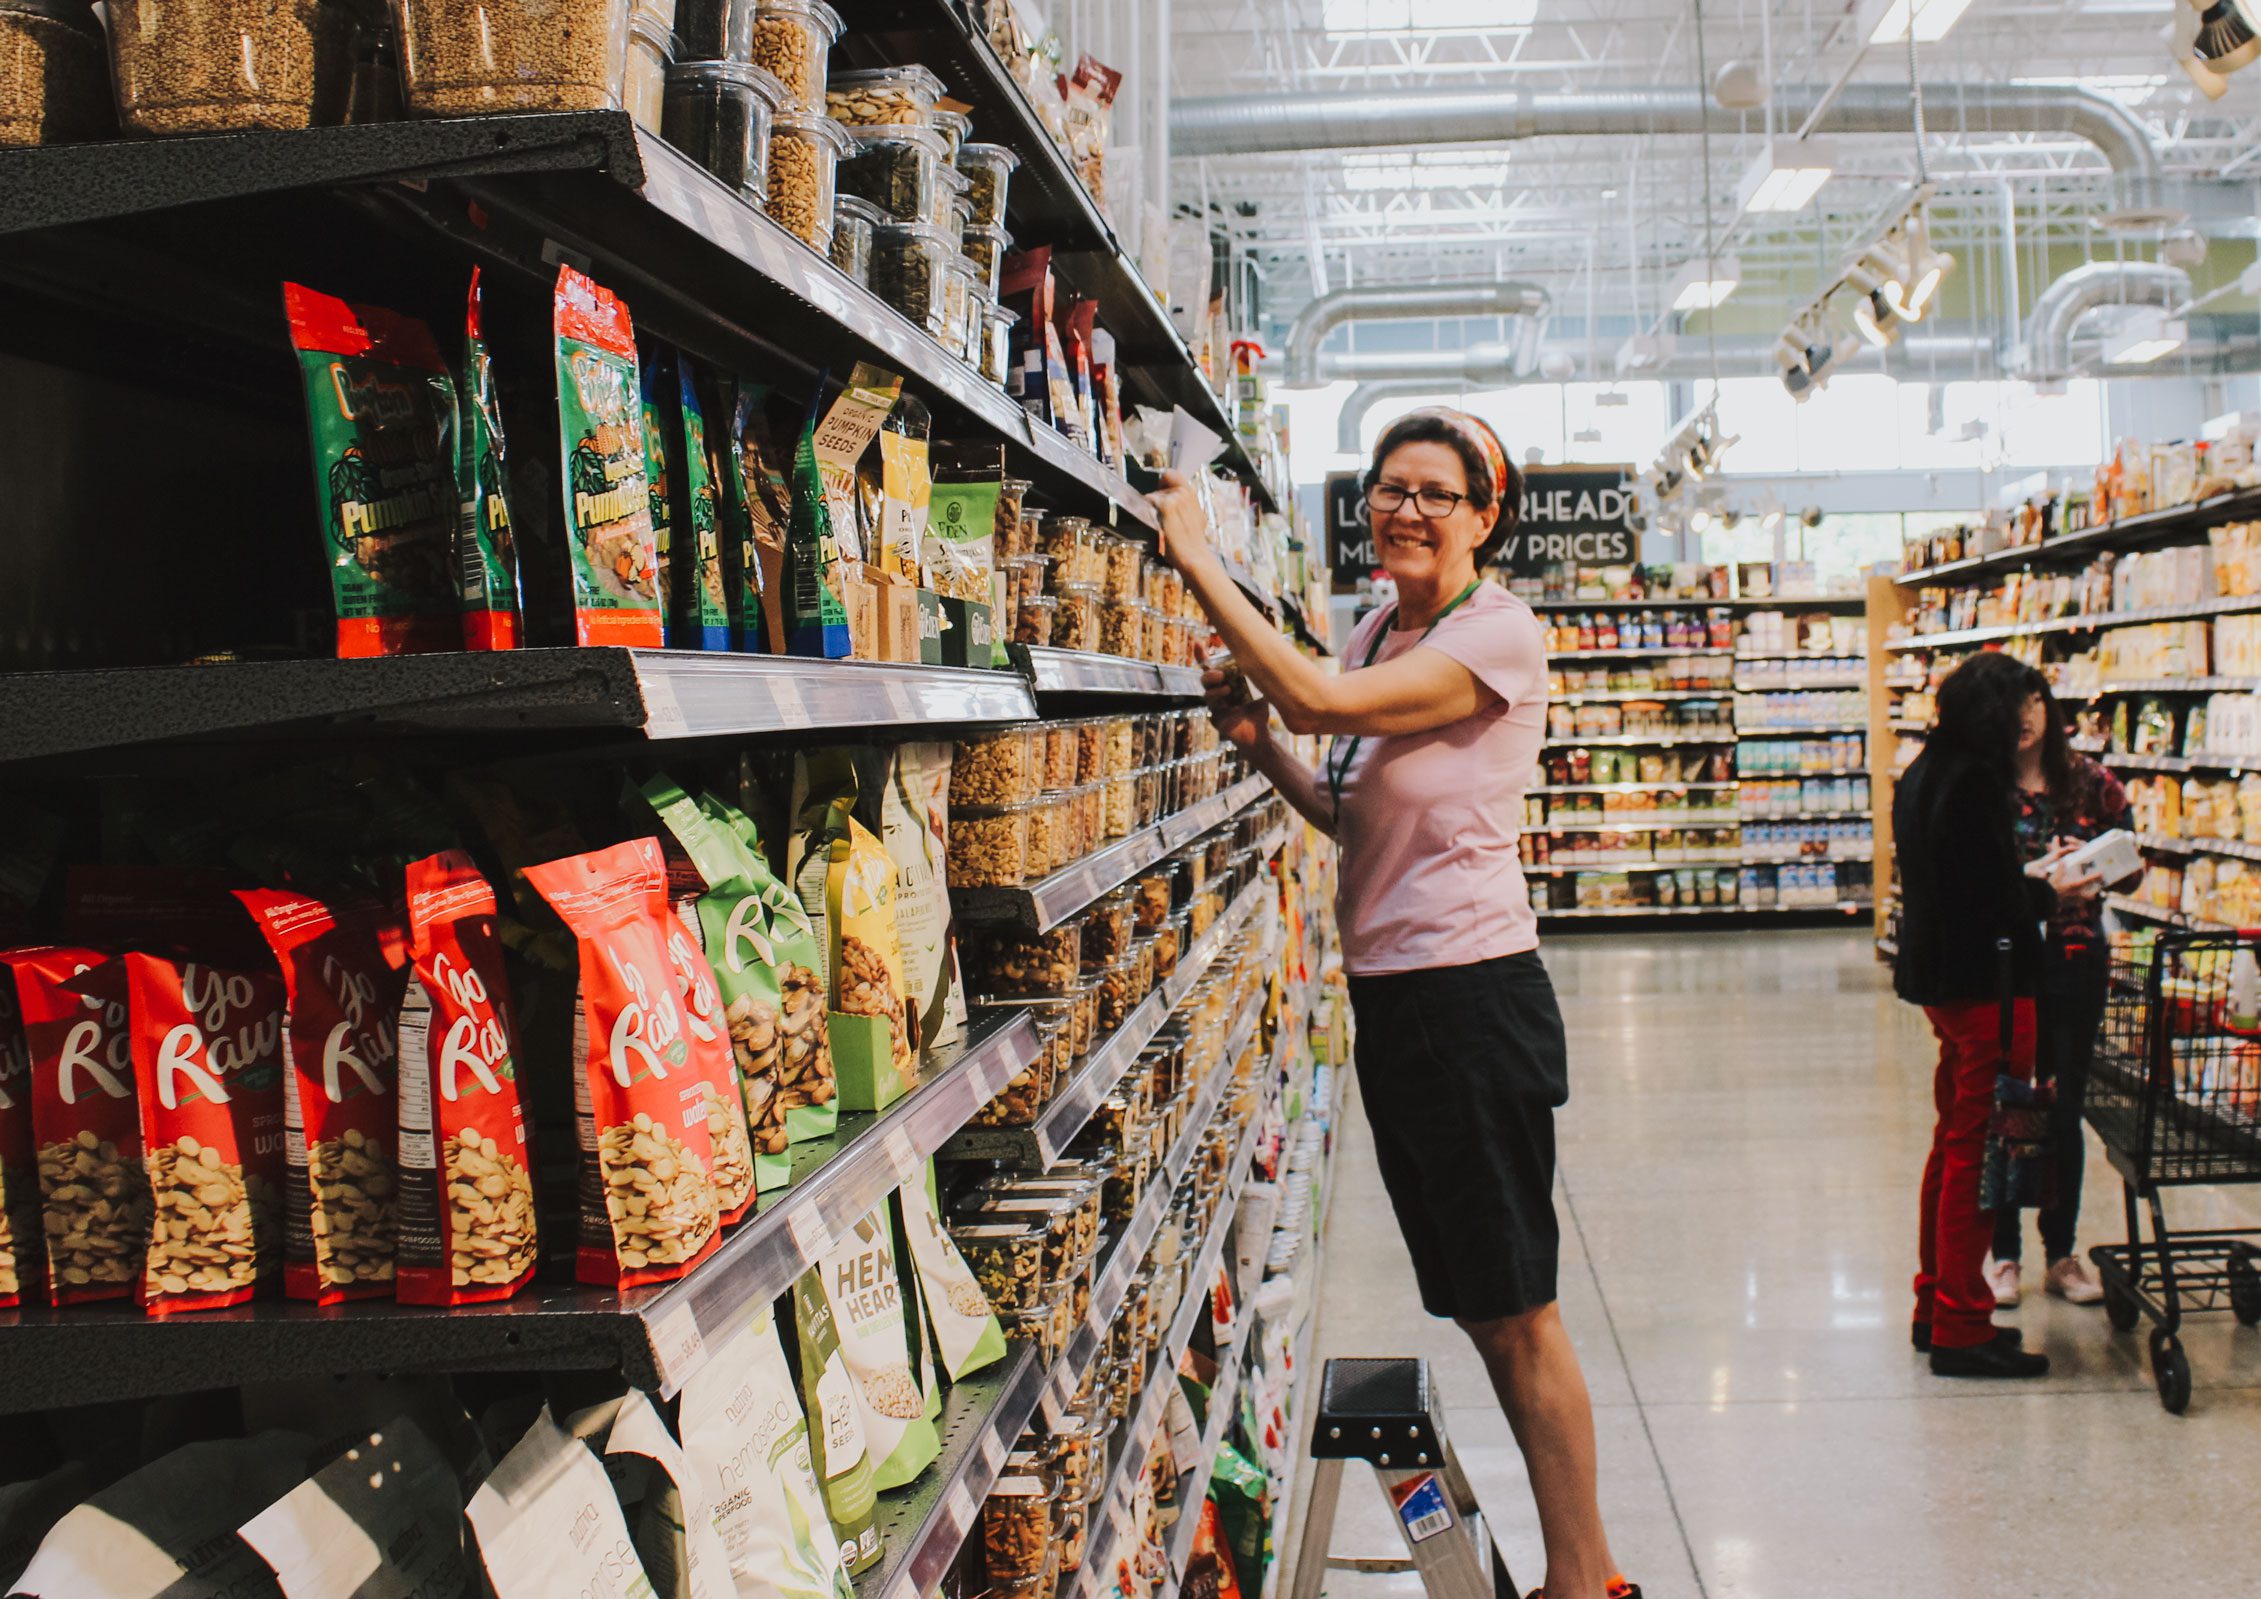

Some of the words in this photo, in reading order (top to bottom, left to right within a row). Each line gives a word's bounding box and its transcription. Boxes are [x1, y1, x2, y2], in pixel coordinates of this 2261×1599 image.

[828, 416, 876, 441] PUMPKIN
[842, 407, 874, 423] ORGANIC
[818, 434, 857, 453] SEEDS
[938, 521, 968, 539] EDEN
[1527, 532, 1629, 561] PRICES
[609, 989, 680, 1088] Raw
[156, 1010, 280, 1111] Raw
[716, 1393, 791, 1489] hempseed
